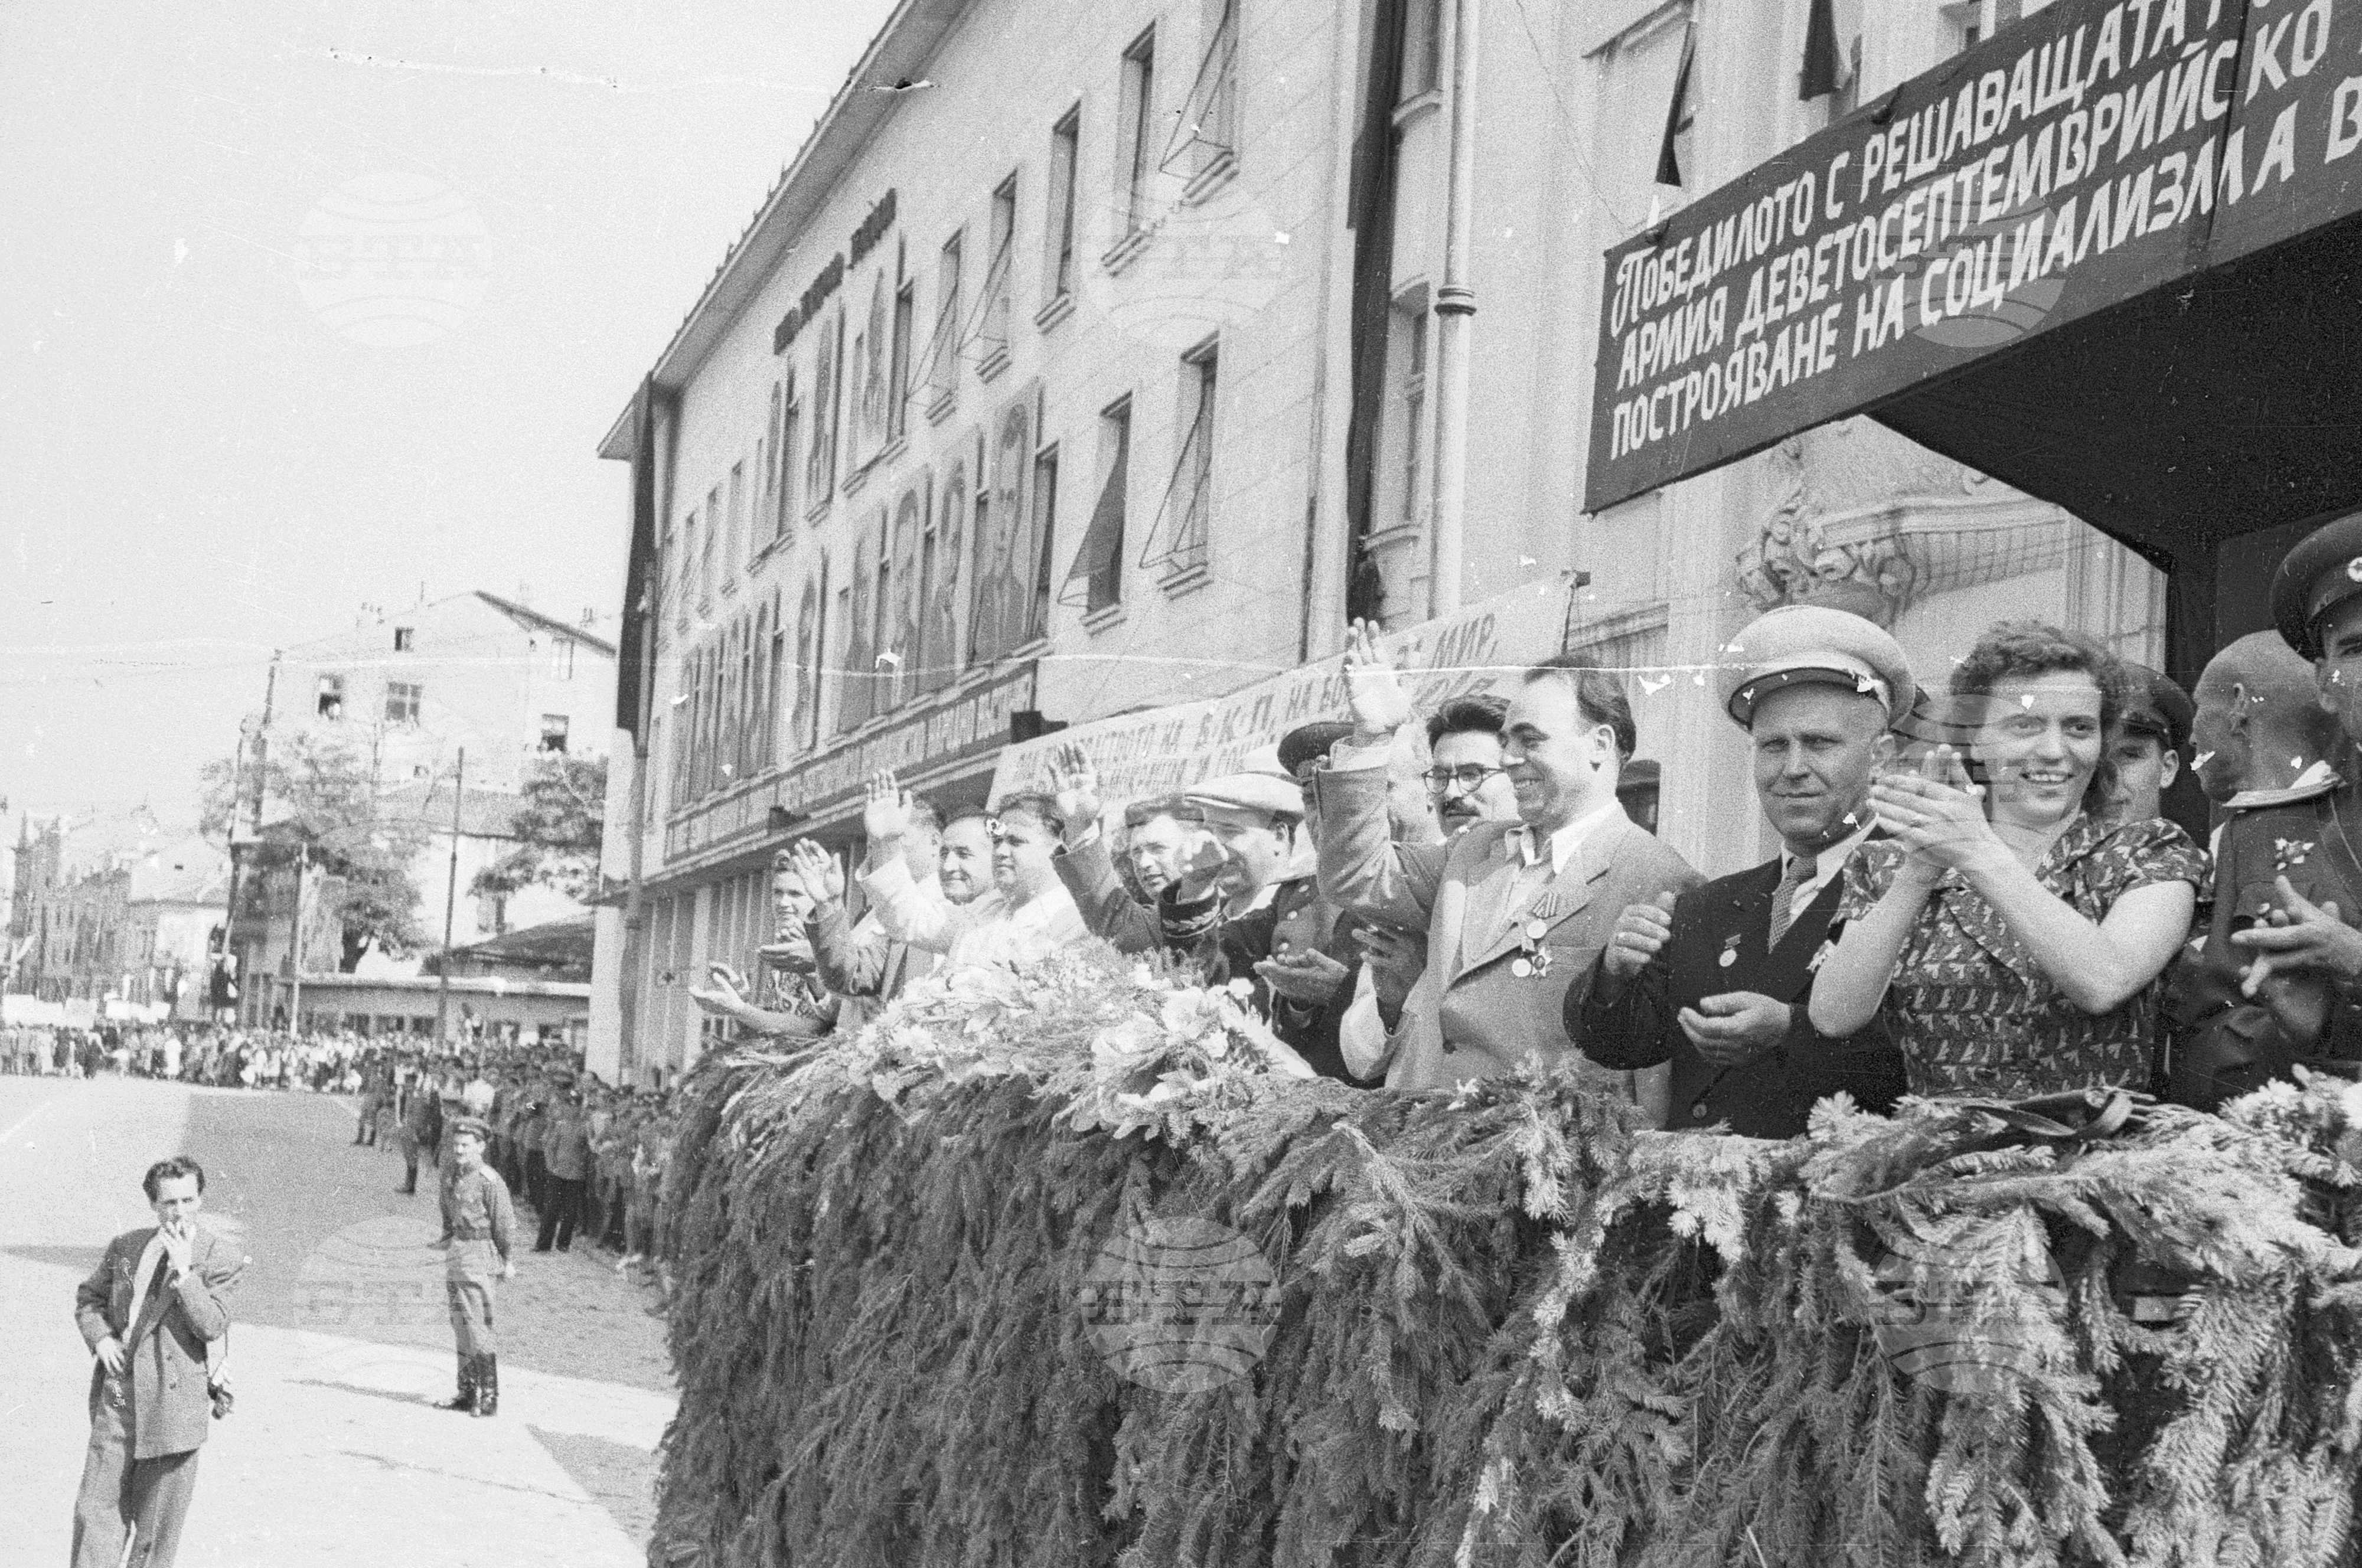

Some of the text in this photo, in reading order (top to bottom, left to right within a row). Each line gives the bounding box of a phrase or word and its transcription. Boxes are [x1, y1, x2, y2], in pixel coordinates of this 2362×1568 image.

[1610, 0, 2186, 337] ПОБЕДИЛОТО С РЕШАВАЩАТА
[1610, 302, 1842, 460] ПОСТРОЯВАНЕ
[1852, 272, 1905, 358] НА
[1919, 99, 2299, 327] СОЦИАЛИЗМА
[1616, 0, 2332, 391] АРМИЯ ДЕВЕТОСЕПТЕМВРИЙСКО
